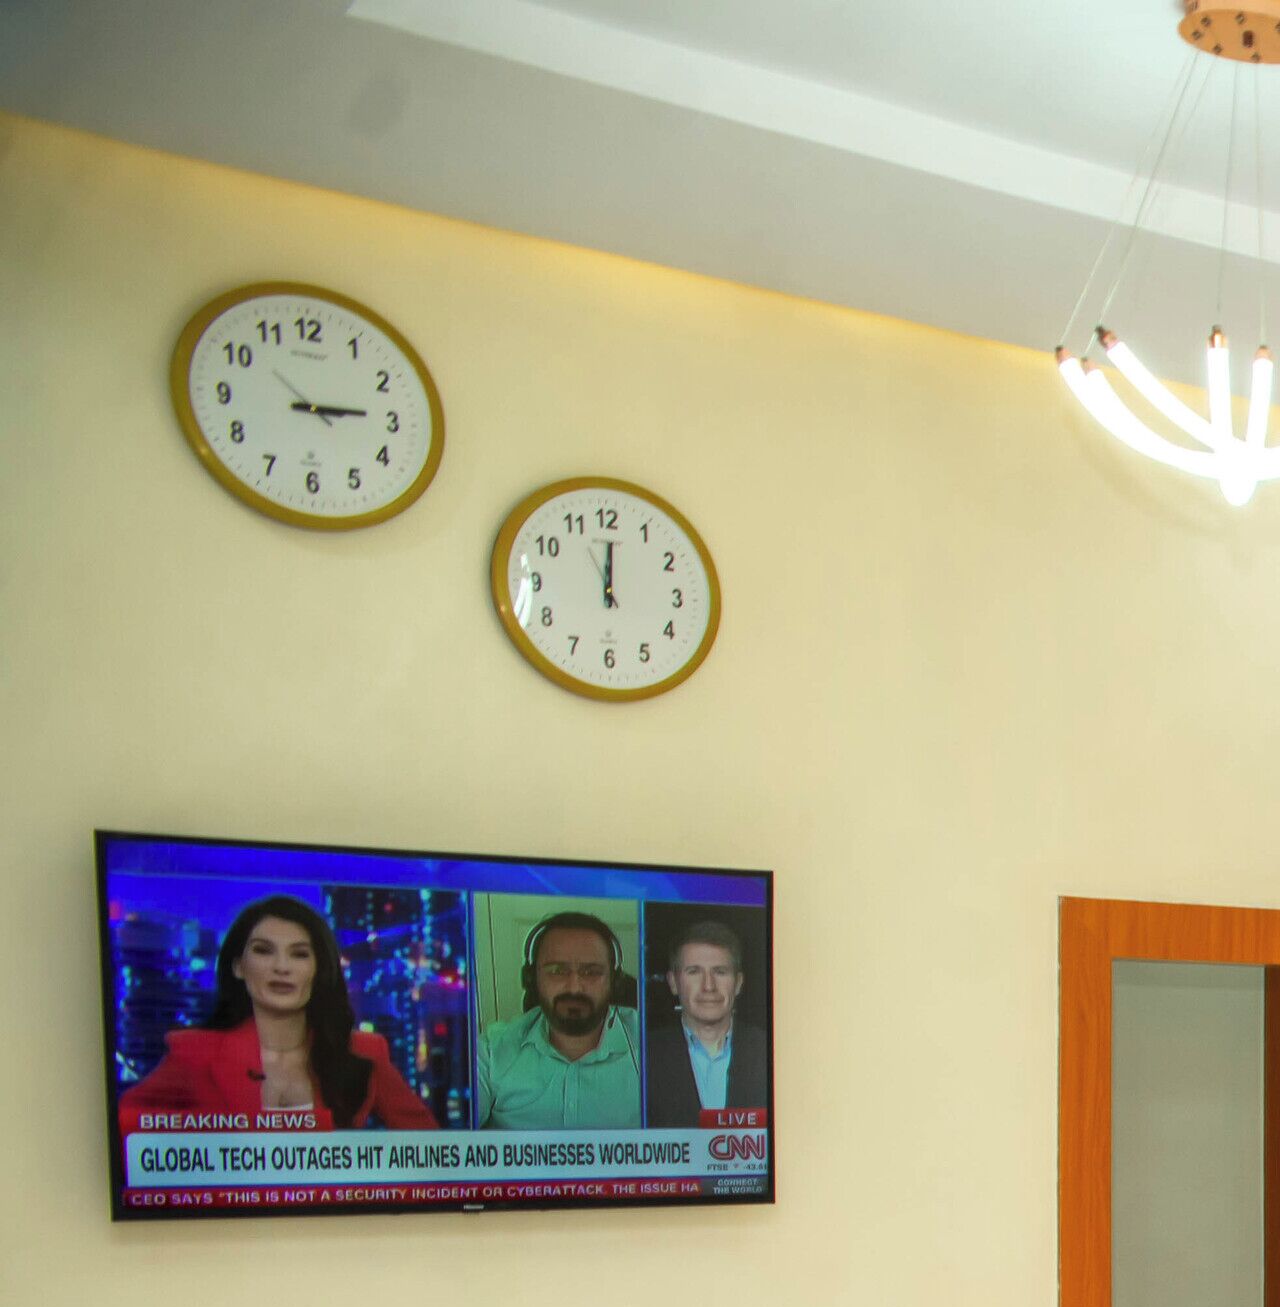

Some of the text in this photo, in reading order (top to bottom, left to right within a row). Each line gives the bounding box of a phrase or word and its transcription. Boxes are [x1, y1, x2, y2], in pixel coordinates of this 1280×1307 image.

[257, 320, 282, 345] 11
[295, 317, 322, 343] 12
[223, 341, 253, 367] 10
[348, 337, 358, 360] 1
[376, 370, 389, 393] 2
[217, 382, 231, 405] 9
[230, 420, 244, 444] 8
[386, 411, 399, 433] 3
[263, 454, 276, 476] 7
[376, 445, 389, 467] 4
[306, 471, 319, 494] 6
[348, 468, 361, 490] 5
[564, 513, 584, 535] 11
[596, 508, 618, 530] 12
[640, 523, 648, 543] 1
[536, 535, 559, 557] 10
[663, 552, 675, 571] 2
[531, 572, 541, 592] 9
[672, 589, 682, 608] 3
[541, 606, 553, 626] 8
[663, 620, 674, 640] 4
[568, 636, 579, 656] 7
[640, 643, 650, 663] 5
[604, 649, 615, 669] 6
[140, 1114, 317, 1129] BREAKING NEWS
[717, 1112, 757, 1126] LIVE
[141, 1142, 690, 1172] GLOBAL TECH OUTAGES HIT AIRLINES AND BUSINESSES WORLDWIDE
[708, 1134, 765, 1161] CNN
[717, 1178, 758, 1187] CONNECT
[731, 1186, 762, 1194] WORLD
[132, 1193, 166, 1206] CEO
[172, 1192, 213, 1205] SAYS
[265, 1191, 279, 1202] IS
[284, 1190, 316, 1202] NOT
[320, 1190, 331, 1201] A
[335, 1188, 406, 1201] SECURITY
[412, 1186, 479, 1199] INCIDENT
[482, 1186, 502, 1198] OR
[612, 1183, 636, 1194] THE
[640, 1182, 676, 1193] ISSUE
[681, 1182, 699, 1193] HA
